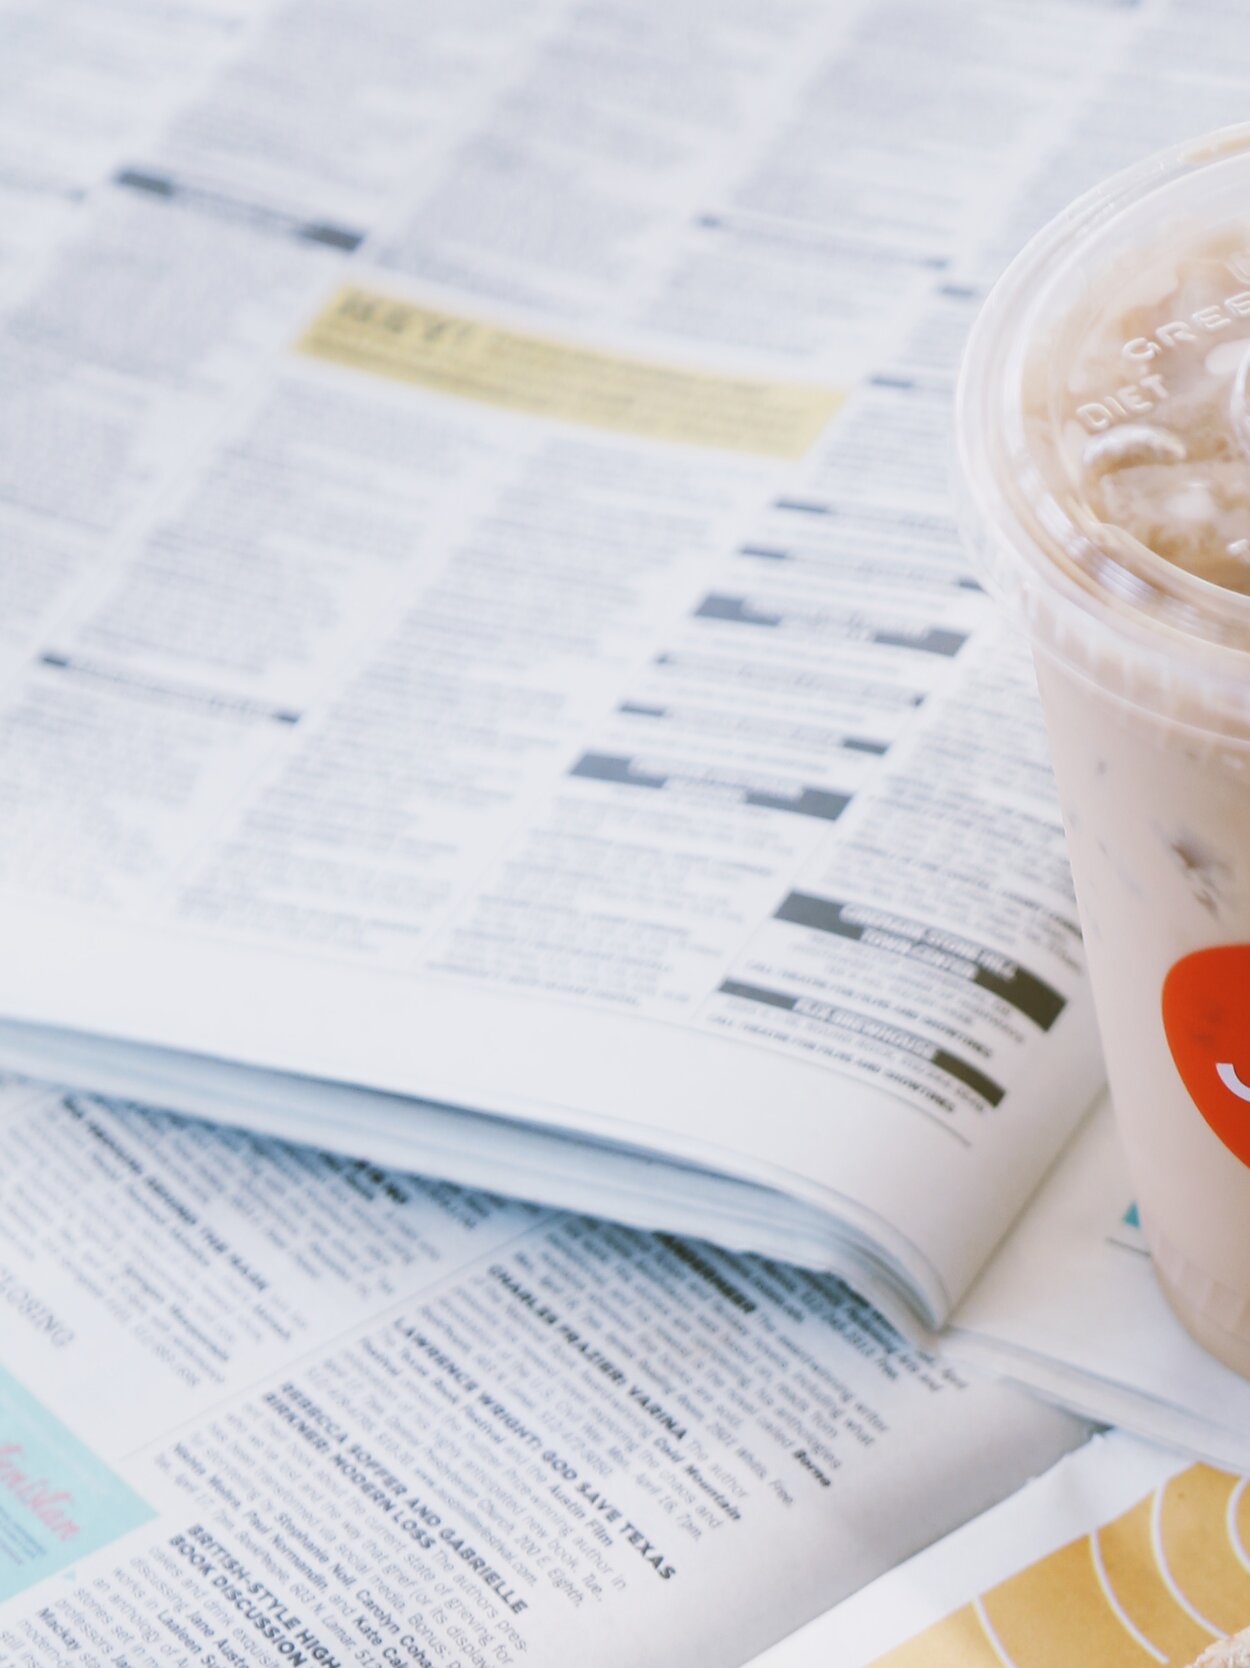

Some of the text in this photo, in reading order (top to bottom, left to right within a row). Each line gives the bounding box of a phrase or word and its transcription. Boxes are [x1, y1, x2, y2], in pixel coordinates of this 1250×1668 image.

[1076, 374, 1170, 429] DIET
[627, 1384, 688, 1441] VARINA
[393, 1318, 479, 1393] LAWRENCE
[540, 1449, 579, 1481] GOD
[574, 1480, 623, 1524] SAVE
[619, 1520, 677, 1581] TEXAS
[331, 1452, 396, 1513] MODERN
[391, 1509, 437, 1550] LOSS
[450, 1572, 500, 1620] authors
[547, 1482, 615, 1548] Austin Film
[187, 1524, 302, 1632] BRITISH-STYLE
[404, 1496, 442, 1528] AND
[437, 1527, 529, 1615] GABRIELLE
[36, 1605, 82, 1652] Mackay
[168, 1533, 216, 1578] BOOK
[211, 1574, 308, 1668] DISCUSSION
[186, 1609, 216, 1639] Jane
[351, 1613, 384, 1647] Kate
[354, 1587, 402, 1636] Carolyn
[442, 1595, 497, 1649] grieving
[490, 1642, 515, 1666] for
